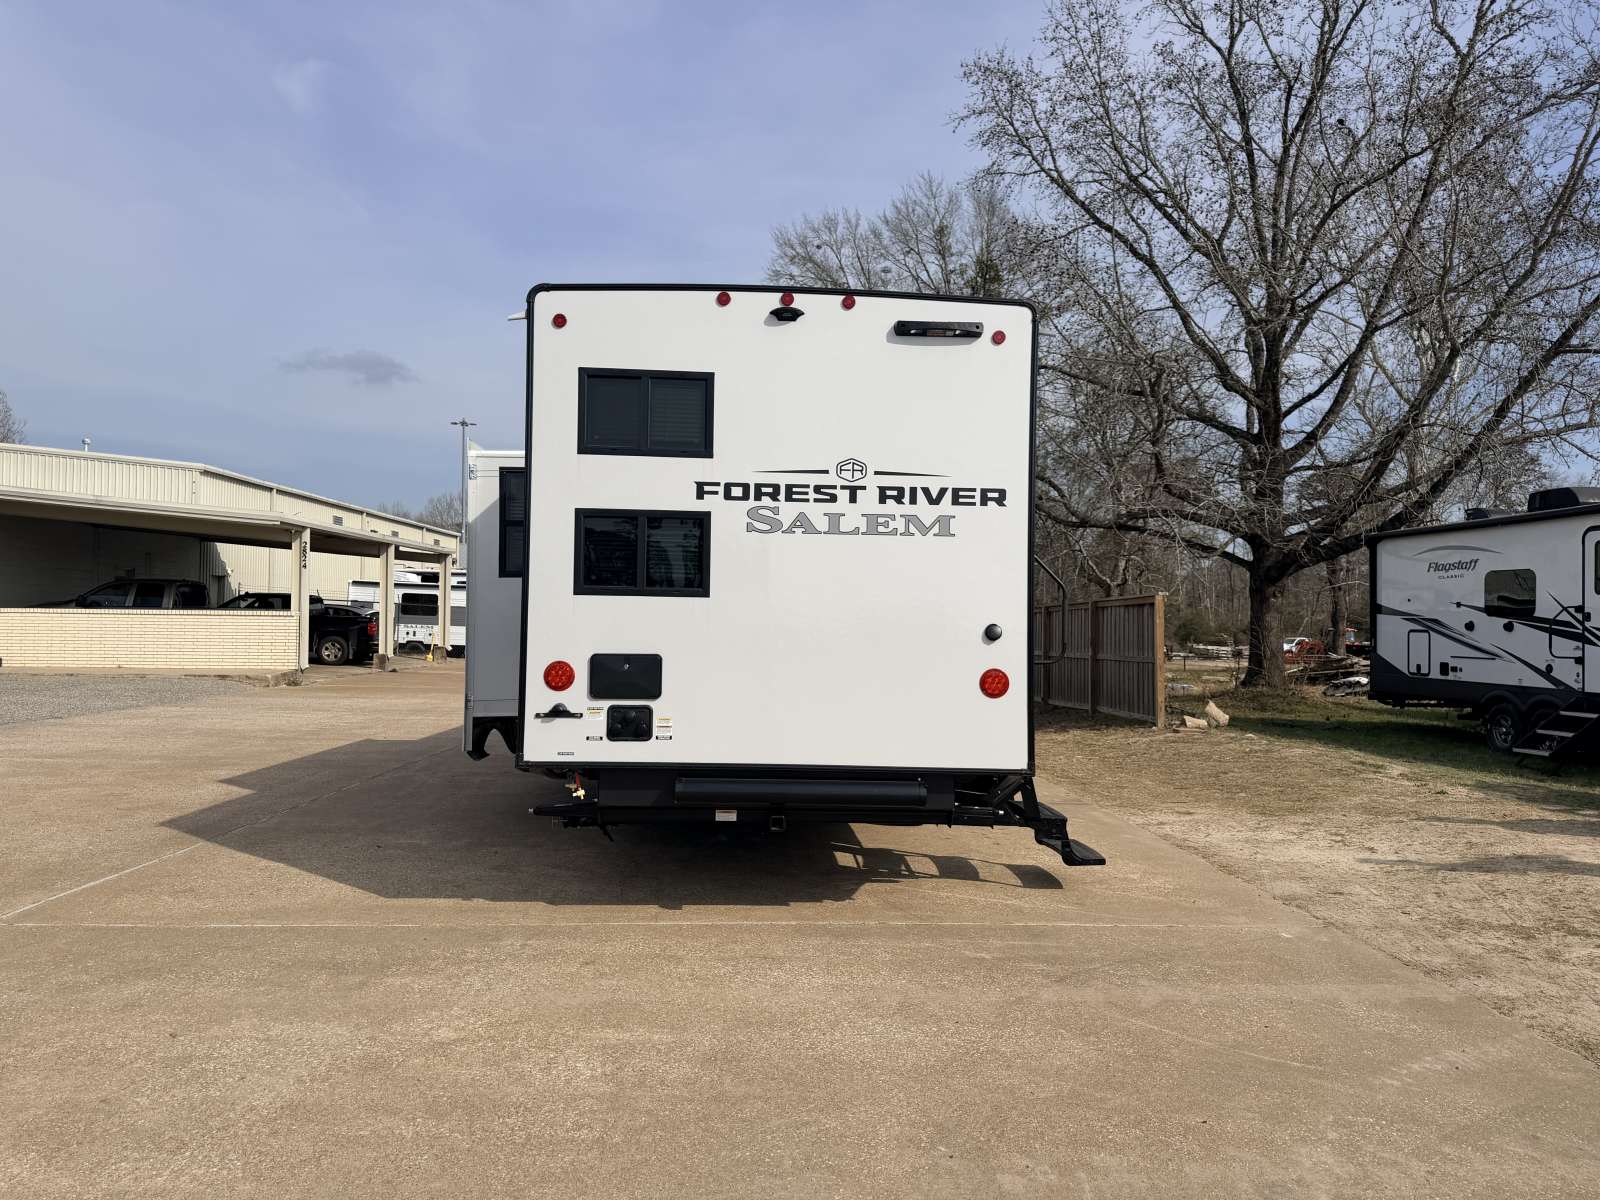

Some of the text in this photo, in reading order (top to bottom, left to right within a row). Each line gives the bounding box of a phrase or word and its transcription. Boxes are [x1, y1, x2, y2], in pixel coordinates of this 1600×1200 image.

[694, 481, 1007, 507] FOREST RIVER
[746, 505, 956, 537] SALEM
[1427, 558, 1480, 573] Flagstaff
